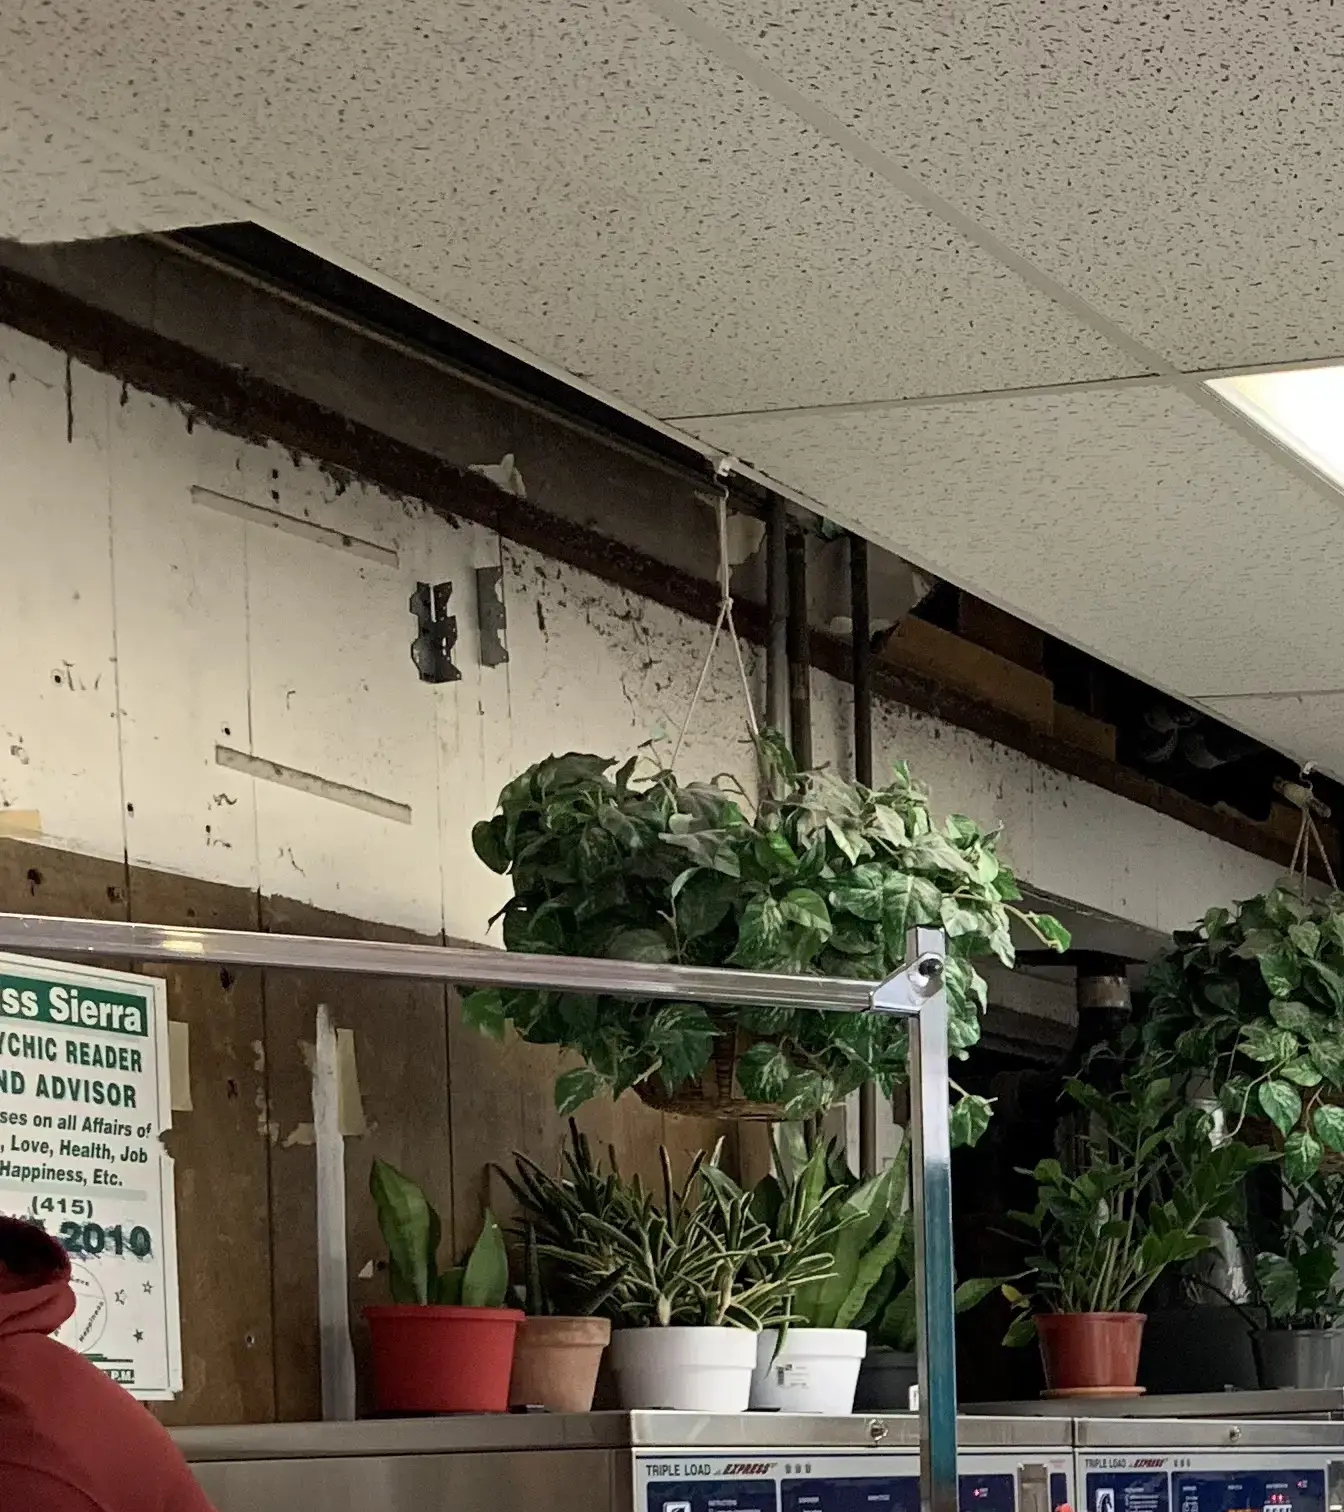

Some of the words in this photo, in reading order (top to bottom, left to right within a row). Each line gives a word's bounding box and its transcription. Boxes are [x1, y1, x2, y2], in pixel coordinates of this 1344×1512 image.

[49, 986, 142, 1032] Sierra
[66, 1040, 142, 1073] READER
[36, 1074, 136, 1109] ADVISOR
[33, 1114, 52, 1128] on
[57, 1114, 77, 1131] all
[82, 1116, 132, 1137] Affairs
[137, 1123, 152, 1138] of
[11, 1134, 54, 1157] Love,
[60, 1139, 115, 1163] Health,
[120, 1146, 148, 1163] Job
[0, 1160, 87, 1187] Happiness,
[93, 1168, 123, 1187] Etc.
[31, 1196, 93, 1219] (415)
[646, 1464, 681, 1477] TRIPLE
[684, 1464, 711, 1476] LOAD
